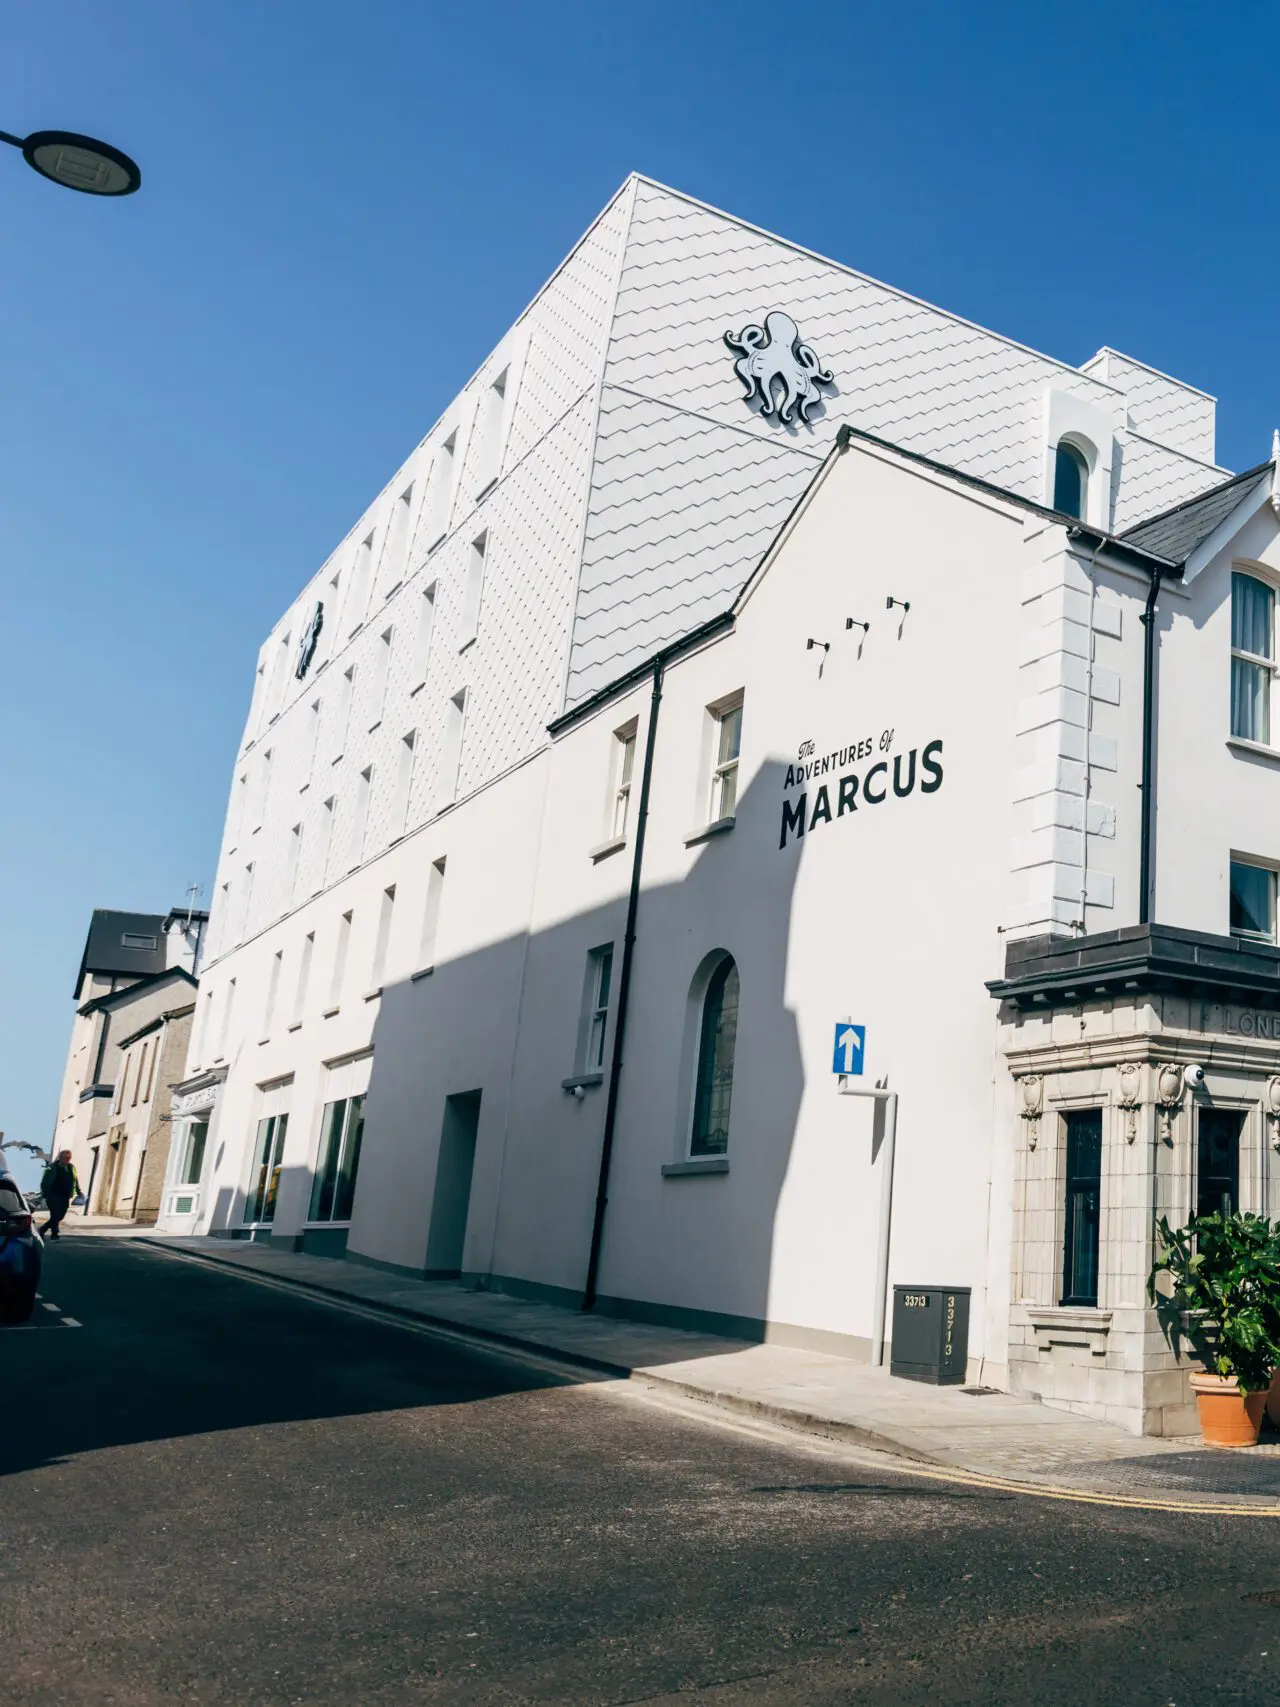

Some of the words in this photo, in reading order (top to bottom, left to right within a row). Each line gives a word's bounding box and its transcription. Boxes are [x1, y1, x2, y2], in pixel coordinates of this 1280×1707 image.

[784, 737, 873, 790] ADVENTURES
[879, 728, 895, 753] Of
[798, 738, 815, 760] The
[779, 739, 944, 850] MARCUS
[905, 1295, 926, 1307] 33713
